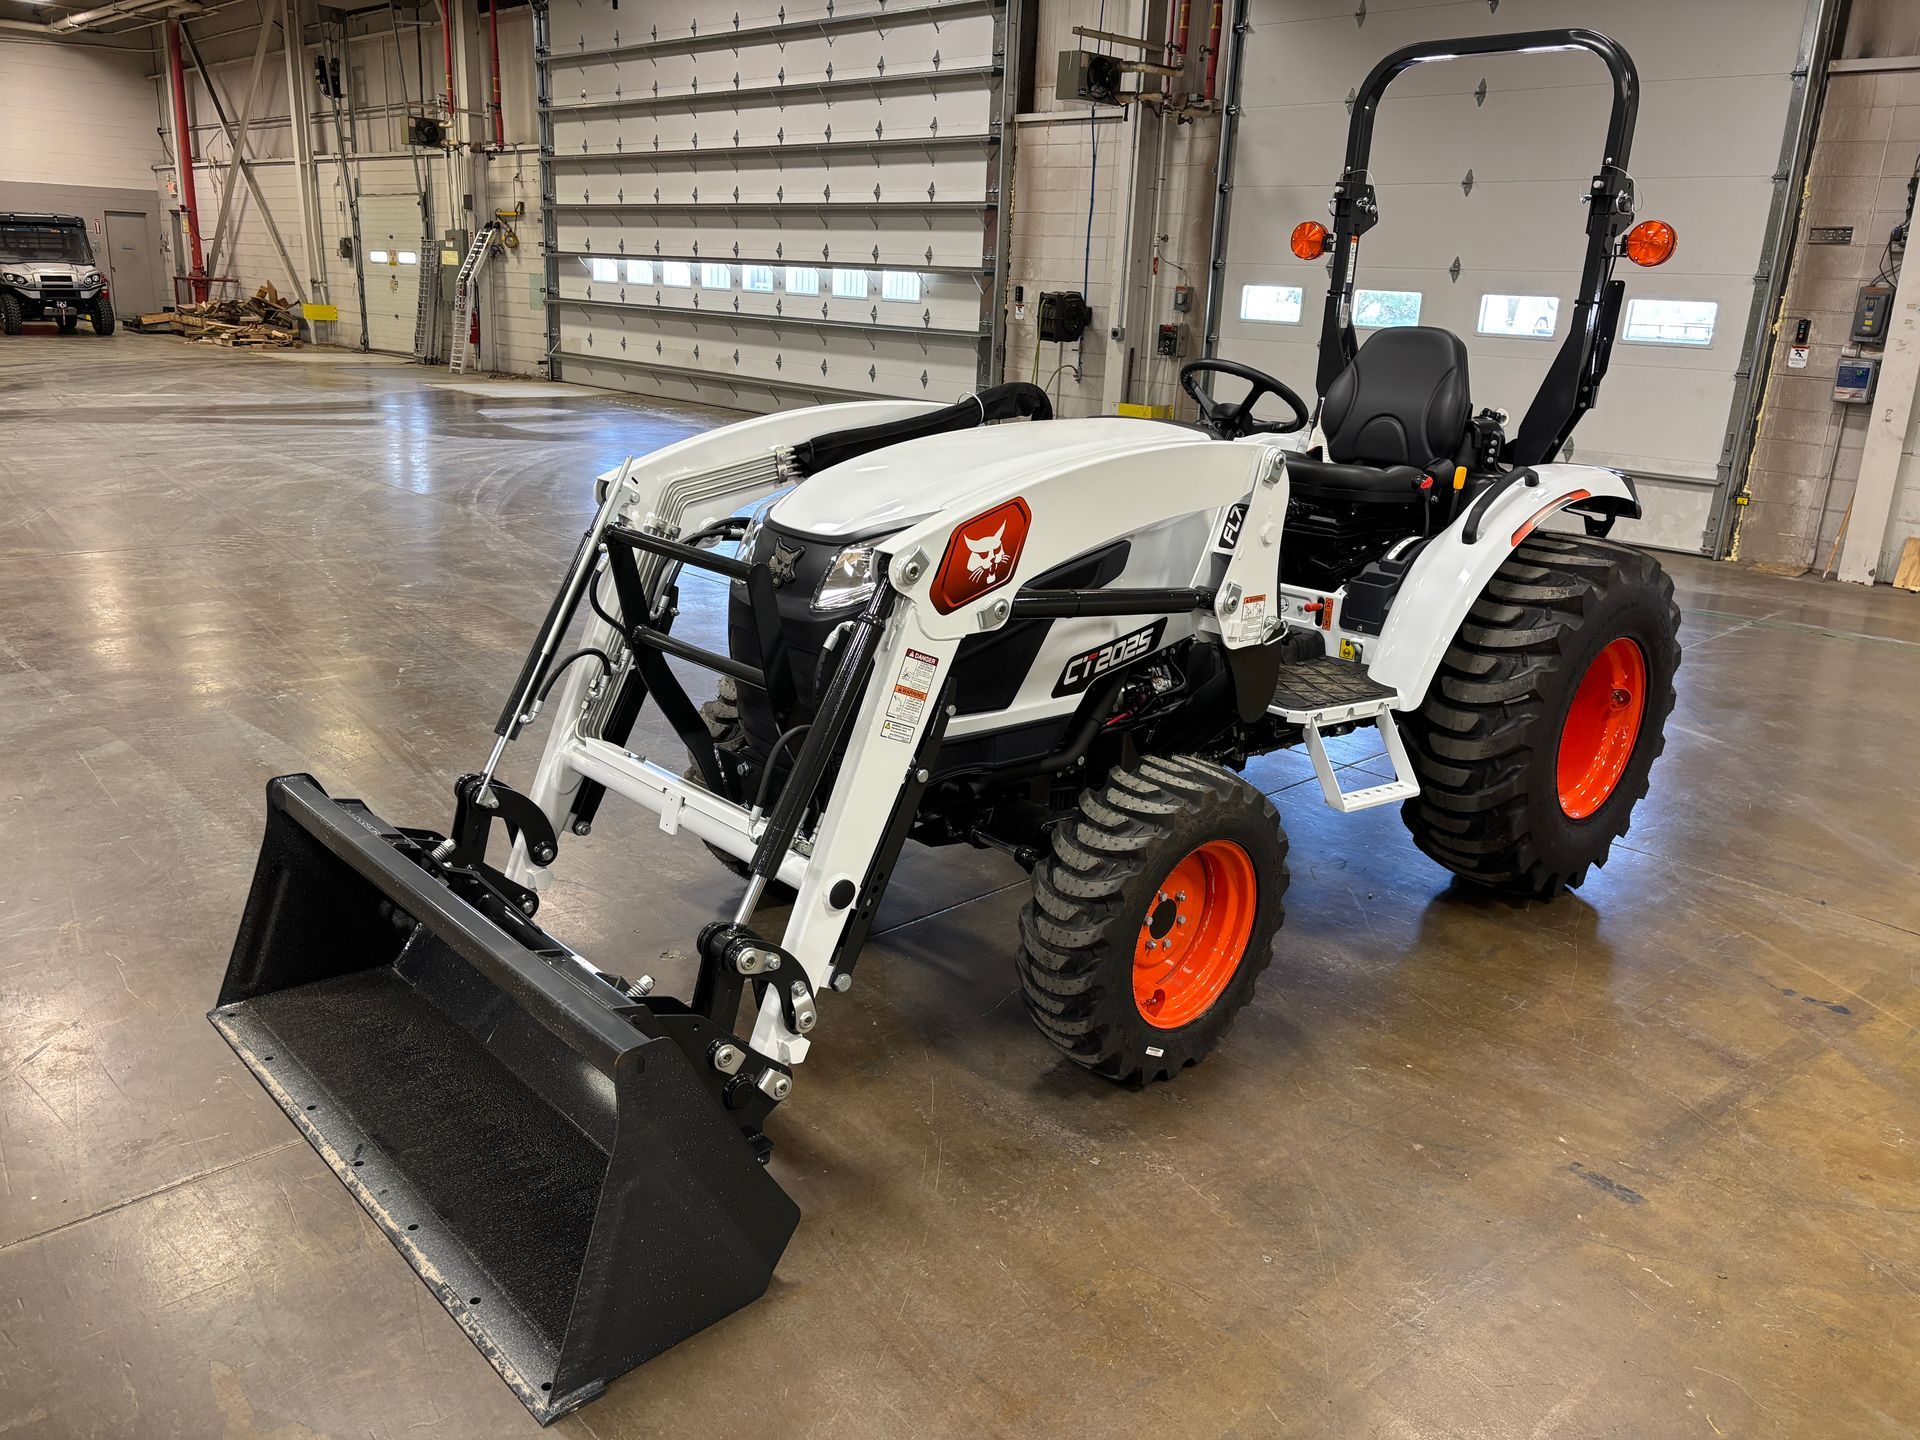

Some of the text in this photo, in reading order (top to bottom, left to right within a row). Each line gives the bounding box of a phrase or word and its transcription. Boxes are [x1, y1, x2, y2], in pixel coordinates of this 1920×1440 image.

[1223, 505, 1242, 545] FL7
[914, 653, 936, 665] DANGER
[1063, 627, 1155, 686] CT2025
[902, 687, 925, 699] WARNING
